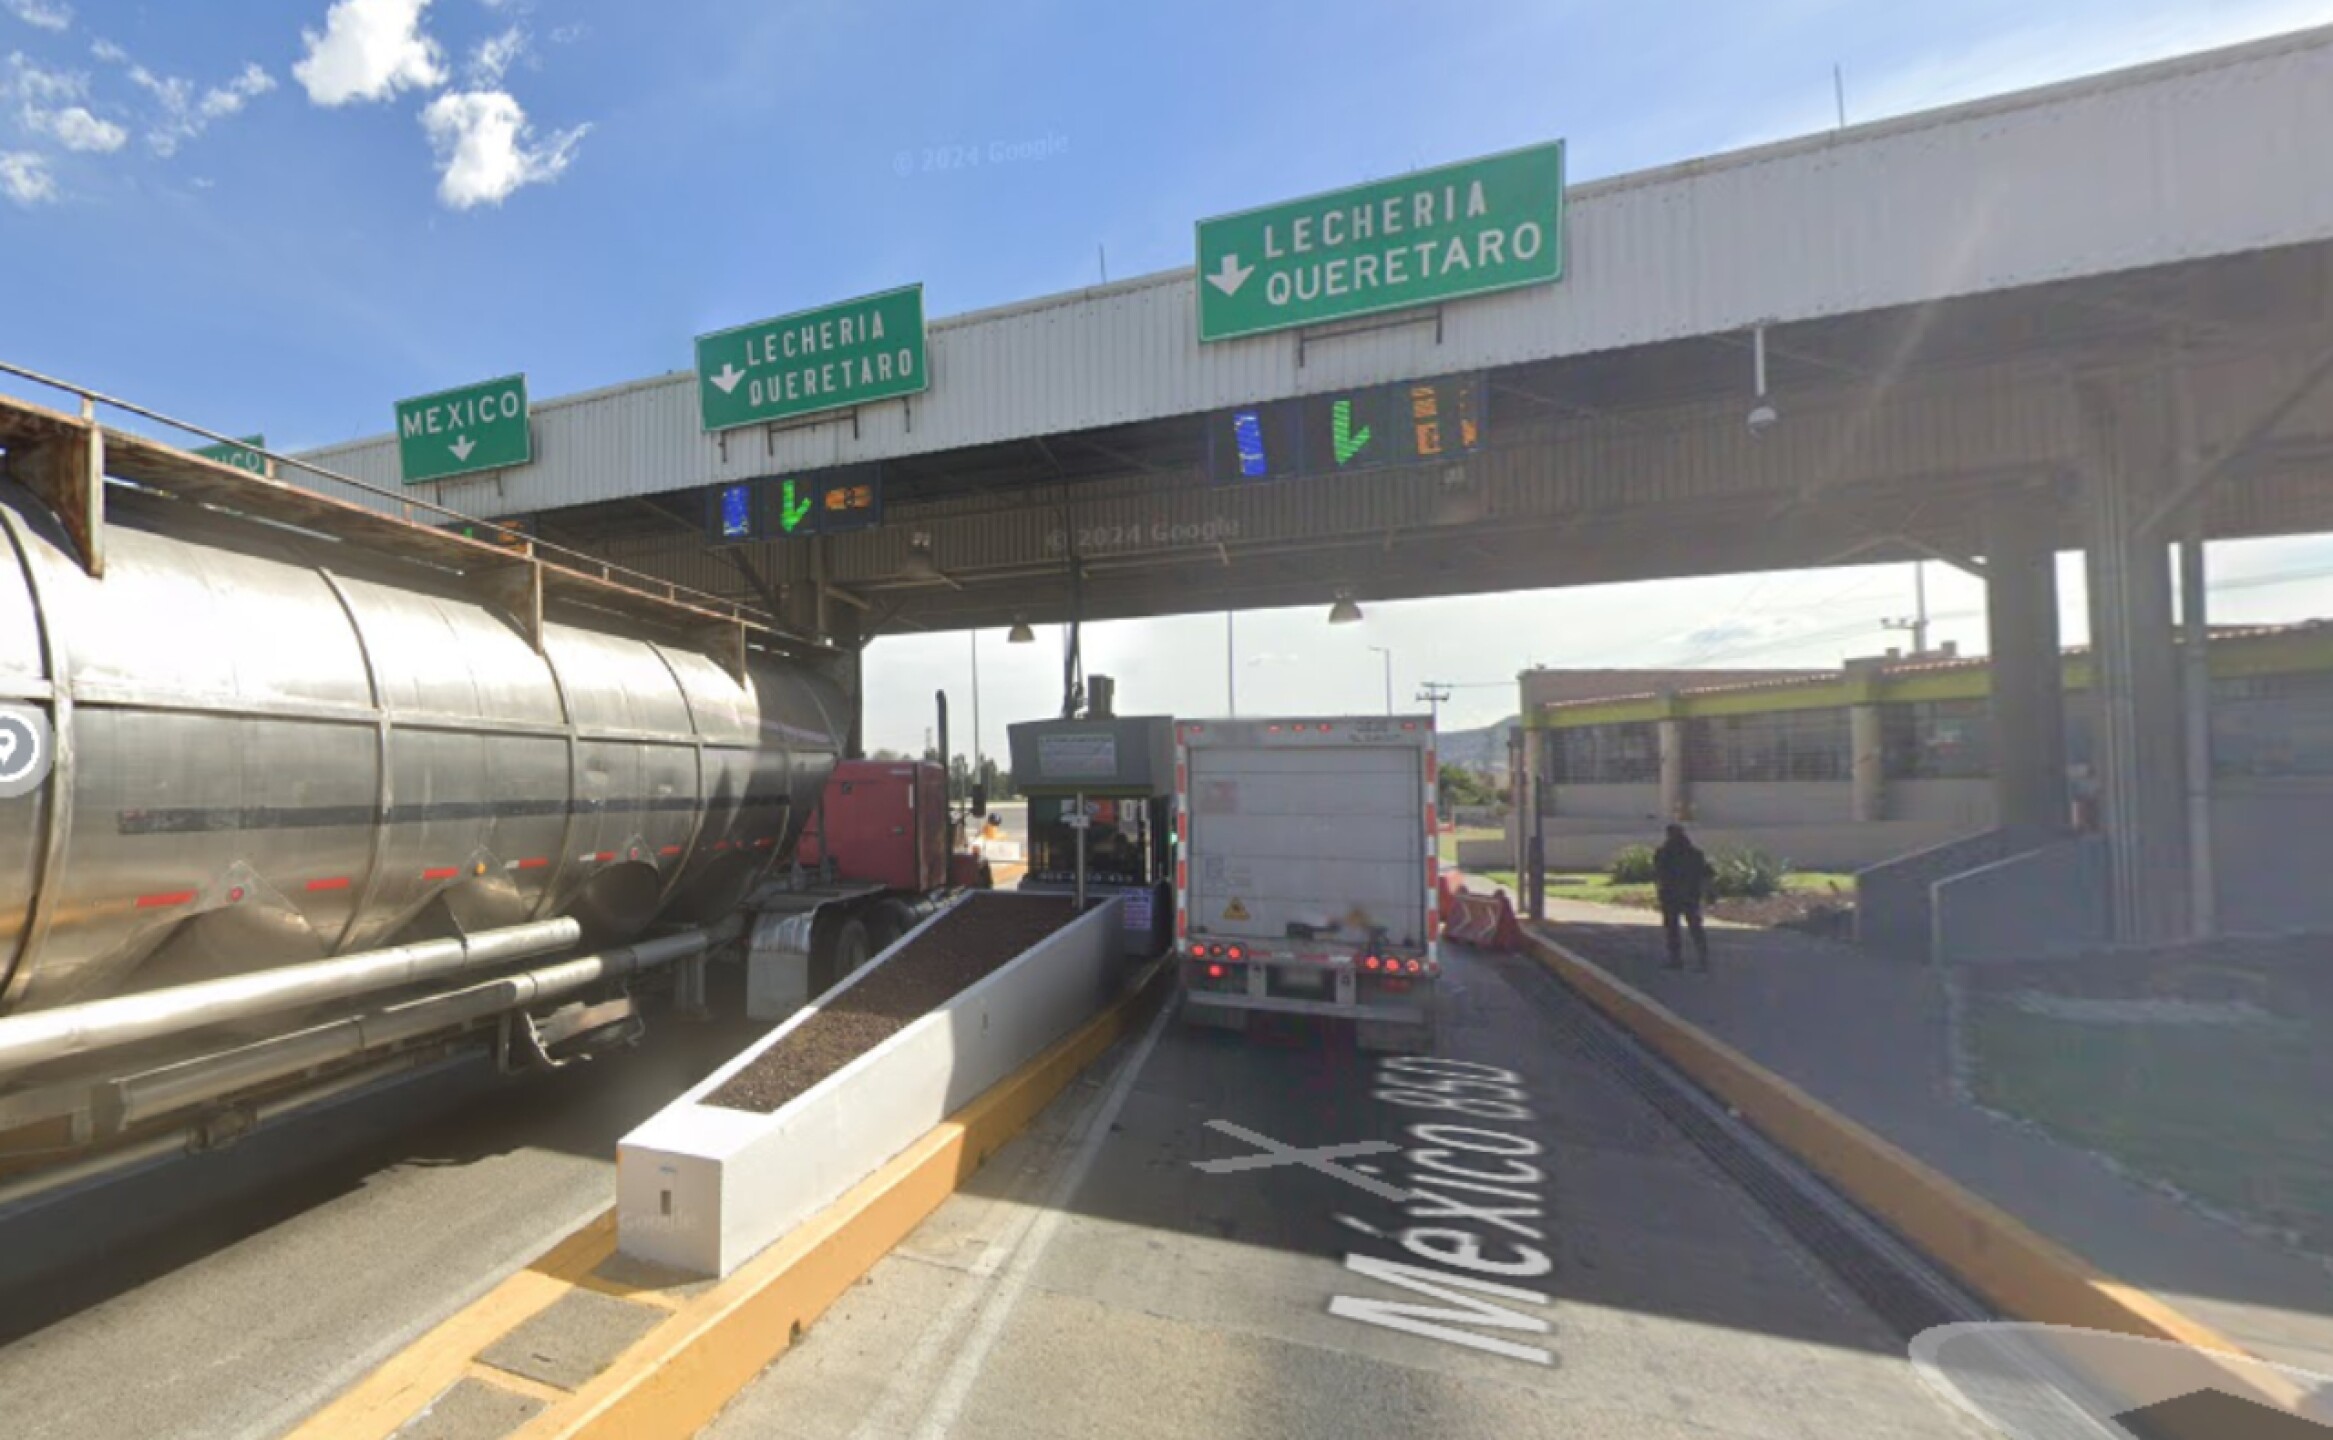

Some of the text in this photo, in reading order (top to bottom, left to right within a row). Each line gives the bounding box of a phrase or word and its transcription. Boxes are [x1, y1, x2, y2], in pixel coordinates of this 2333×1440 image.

[1264, 180, 1487, 258] LECHERIA
[1266, 222, 1541, 305] QUERETARO
[747, 310, 885, 365] LECHERIA
[750, 349, 912, 406] QUERETARO
[403, 391, 519, 439] MEXICO
